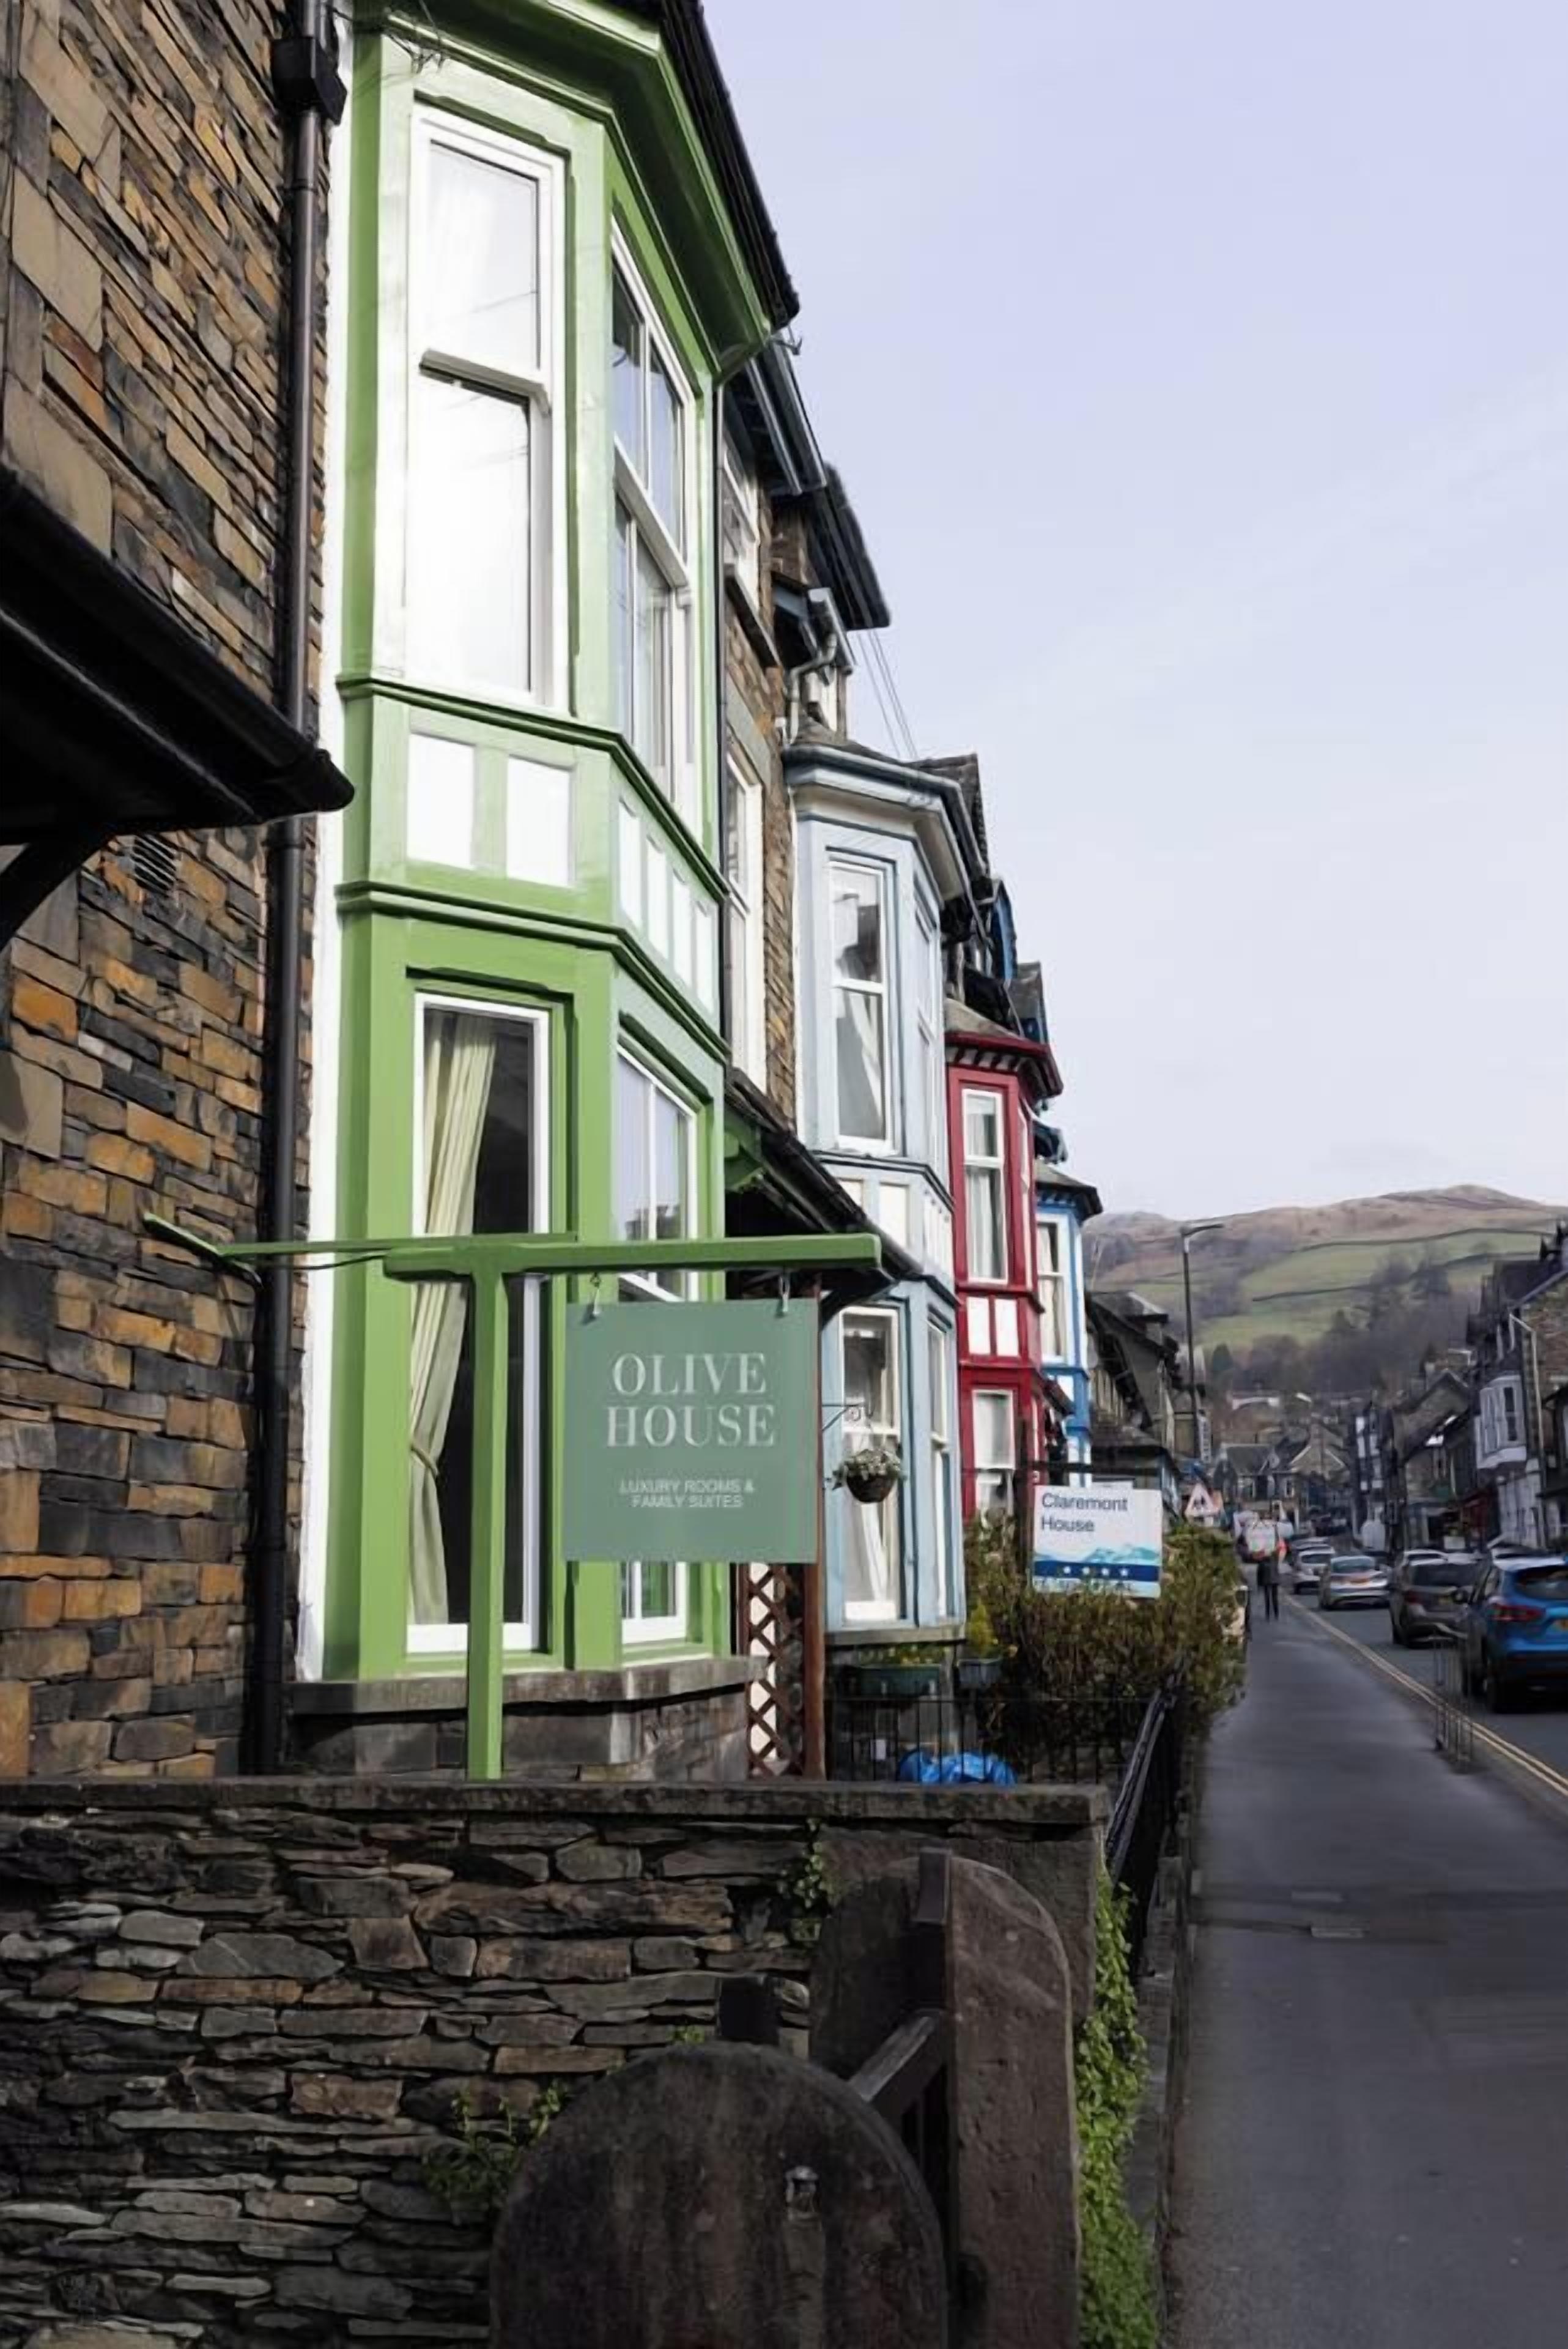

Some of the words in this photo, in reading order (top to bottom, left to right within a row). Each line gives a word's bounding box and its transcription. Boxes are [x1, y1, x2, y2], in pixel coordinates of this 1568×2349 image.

[613, 1353, 766, 1396] OLIVE
[607, 1405, 775, 1447] HOUSE
[619, 1479, 681, 1493] LUXURY
[684, 1479, 742, 1493] ROOMS
[631, 1494, 683, 1508] FAMILY
[688, 1494, 742, 1508] SUITES
[1041, 1493, 1128, 1511] Claremont
[1041, 1515, 1094, 1532] House
